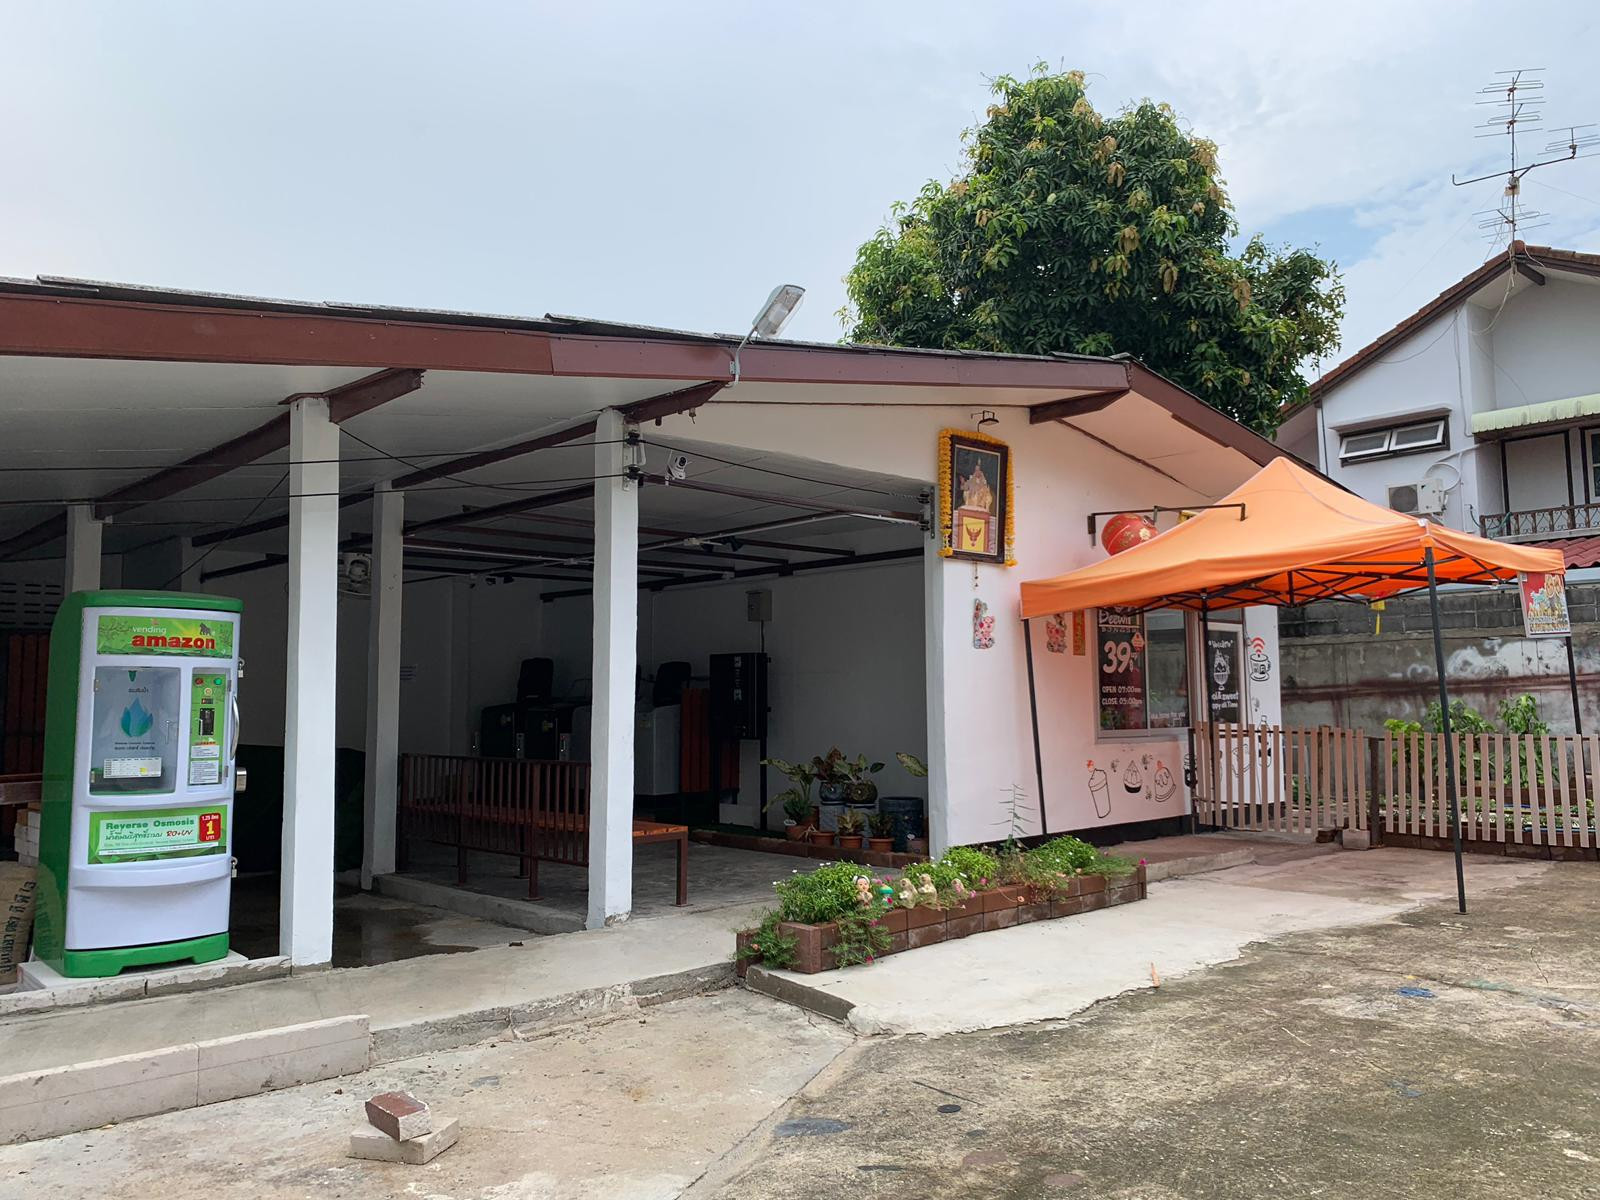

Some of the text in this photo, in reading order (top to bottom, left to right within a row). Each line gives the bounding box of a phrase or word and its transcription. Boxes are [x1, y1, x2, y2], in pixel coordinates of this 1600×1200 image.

[132, 626, 167, 634] vending
[131, 635, 216, 650] amazon
[1103, 640, 1131, 674] 39
[1101, 685, 1117, 693] OPEN
[1101, 697, 1118, 705] CLOSE
[105, 818, 195, 831] Reverse Osmosis
[206, 820, 215, 835] 1
